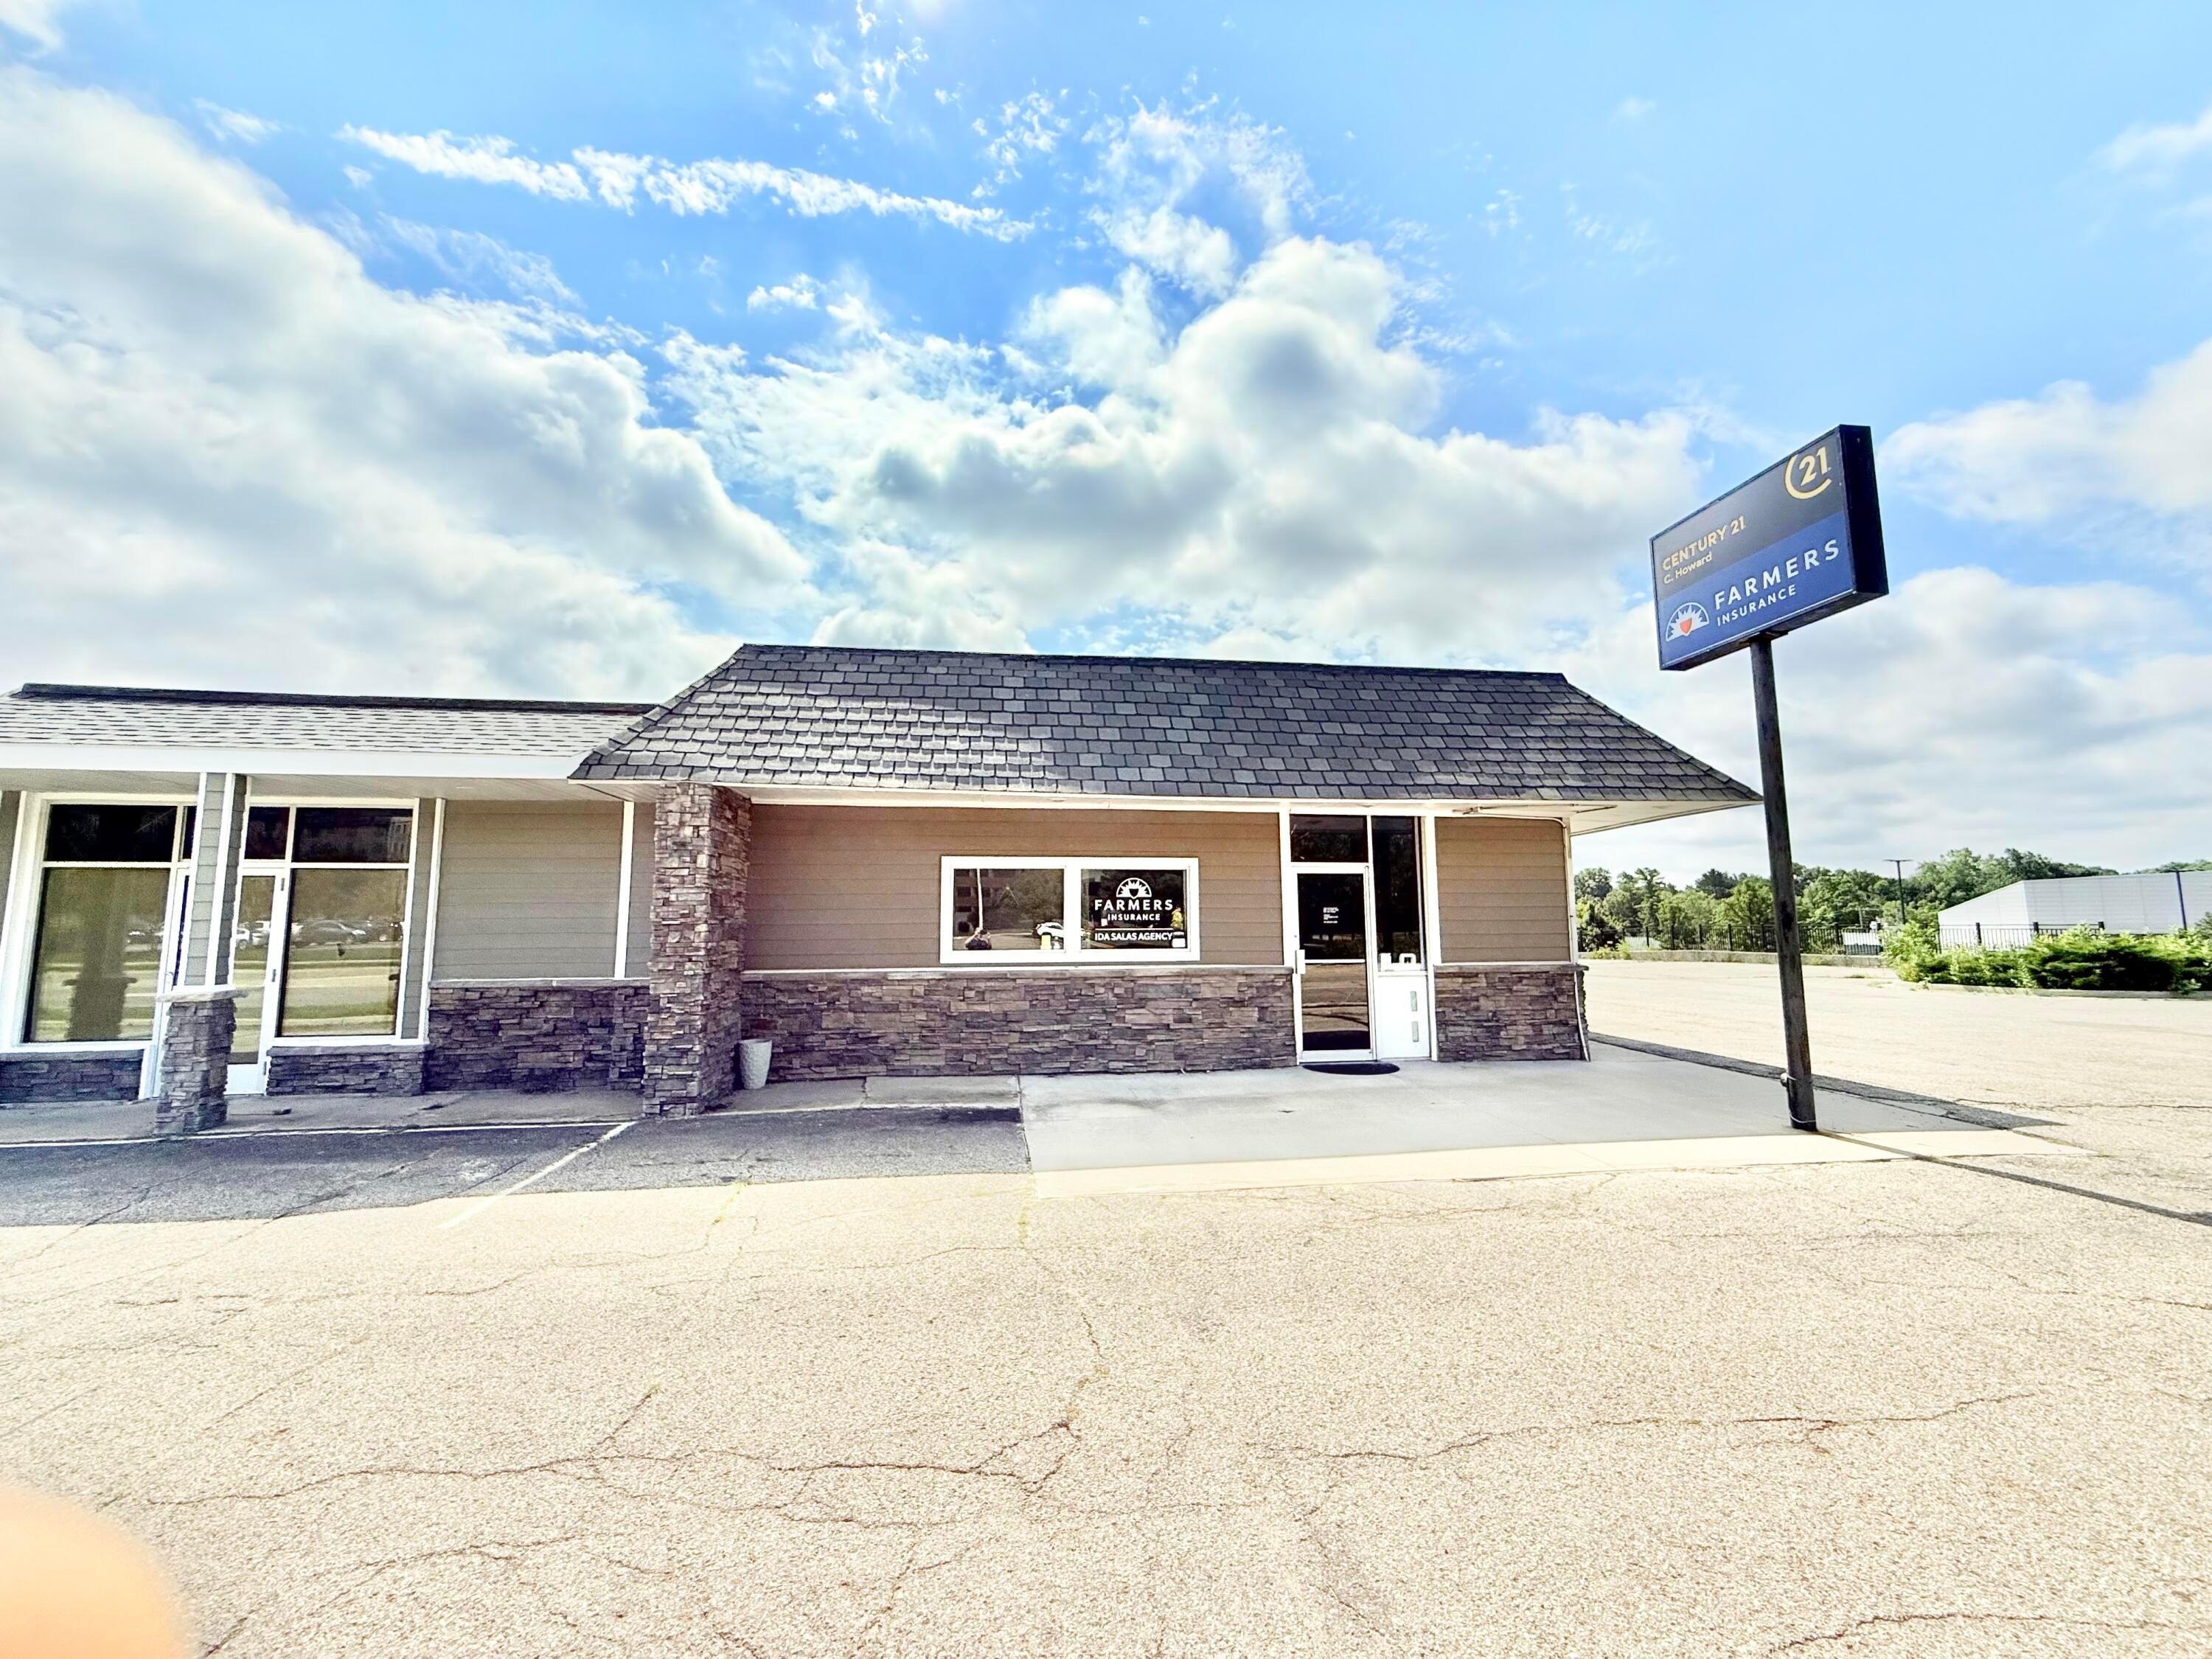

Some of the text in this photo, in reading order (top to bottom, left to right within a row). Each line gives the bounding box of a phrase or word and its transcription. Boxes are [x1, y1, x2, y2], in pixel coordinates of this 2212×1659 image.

[1662, 516, 1745, 571] CENTURY 21
[1663, 552, 1712, 584] C. Howard
[1714, 539, 1839, 611] FARMERS
[1717, 584, 1797, 627] INSURANCE
[1094, 899, 1173, 911] FARMERS
[1094, 933, 1173, 941] IDA SALAS AGENCY
